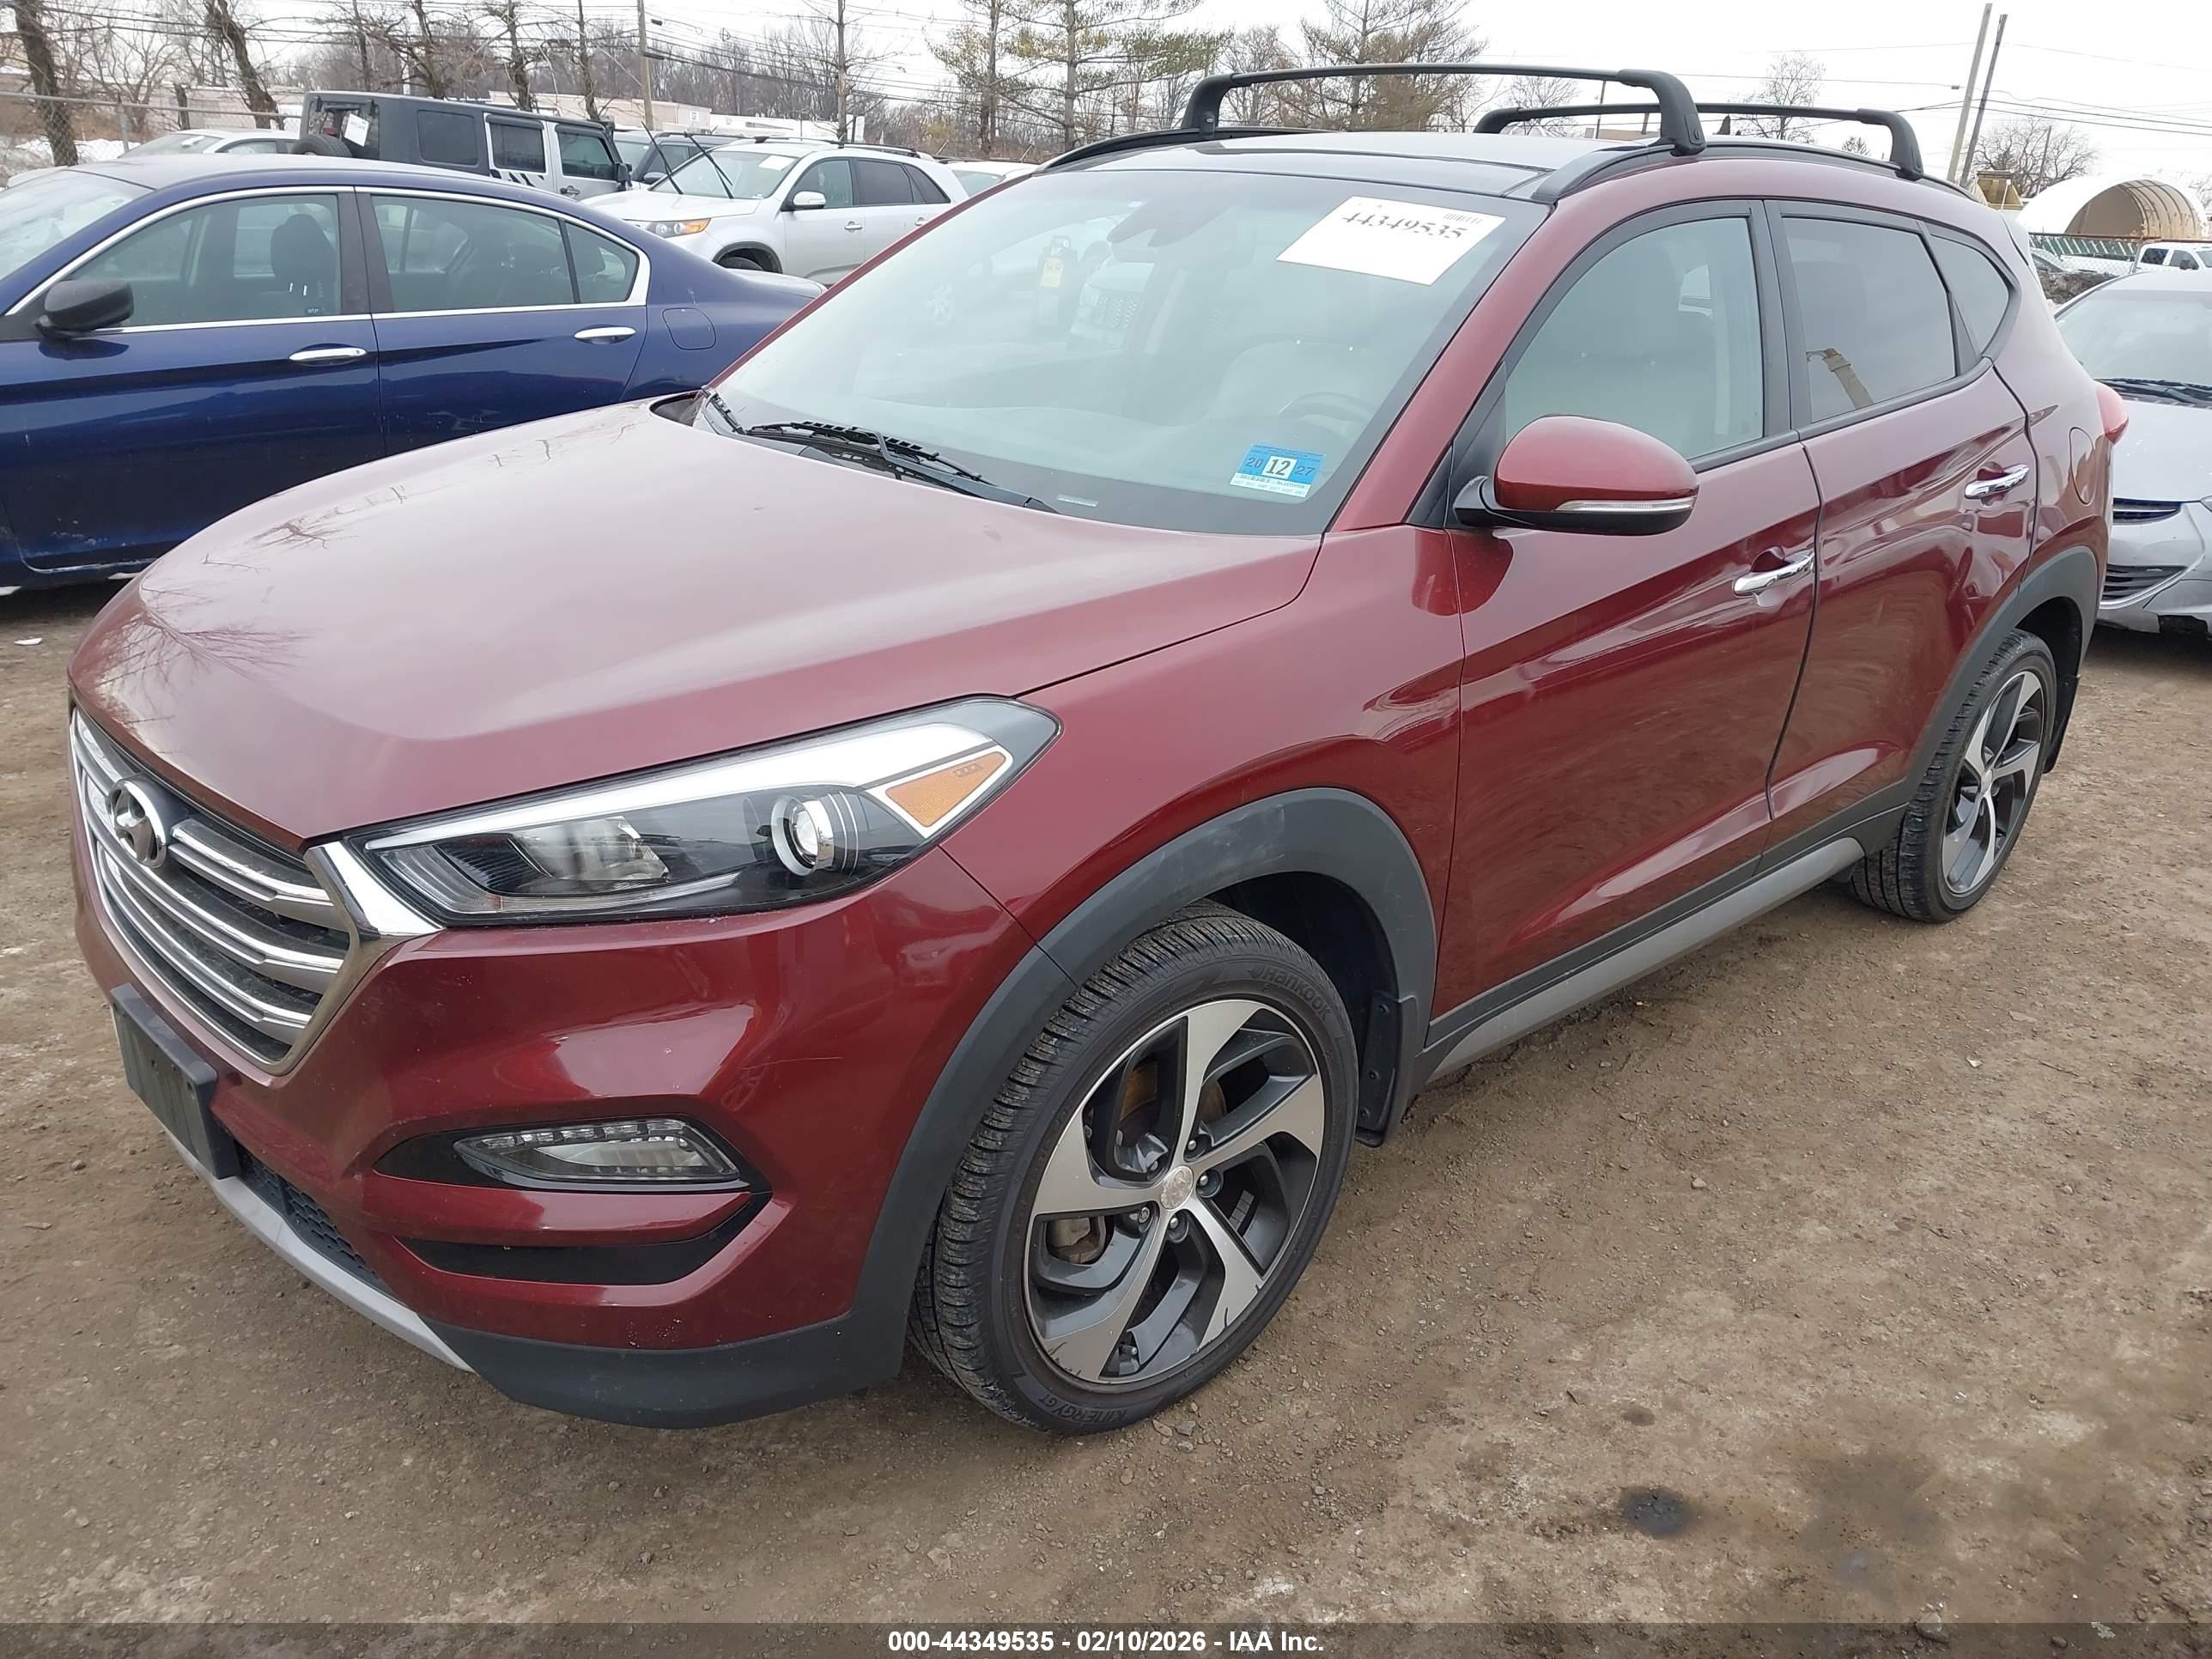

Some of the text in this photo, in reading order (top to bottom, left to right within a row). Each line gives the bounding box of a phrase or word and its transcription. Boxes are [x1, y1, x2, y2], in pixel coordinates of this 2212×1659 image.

[1341, 211, 1468, 239] 44349535
[1266, 458, 1291, 477] 12
[1294, 465, 1316, 477] 27
[1038, 1393, 1058, 1407] GT
